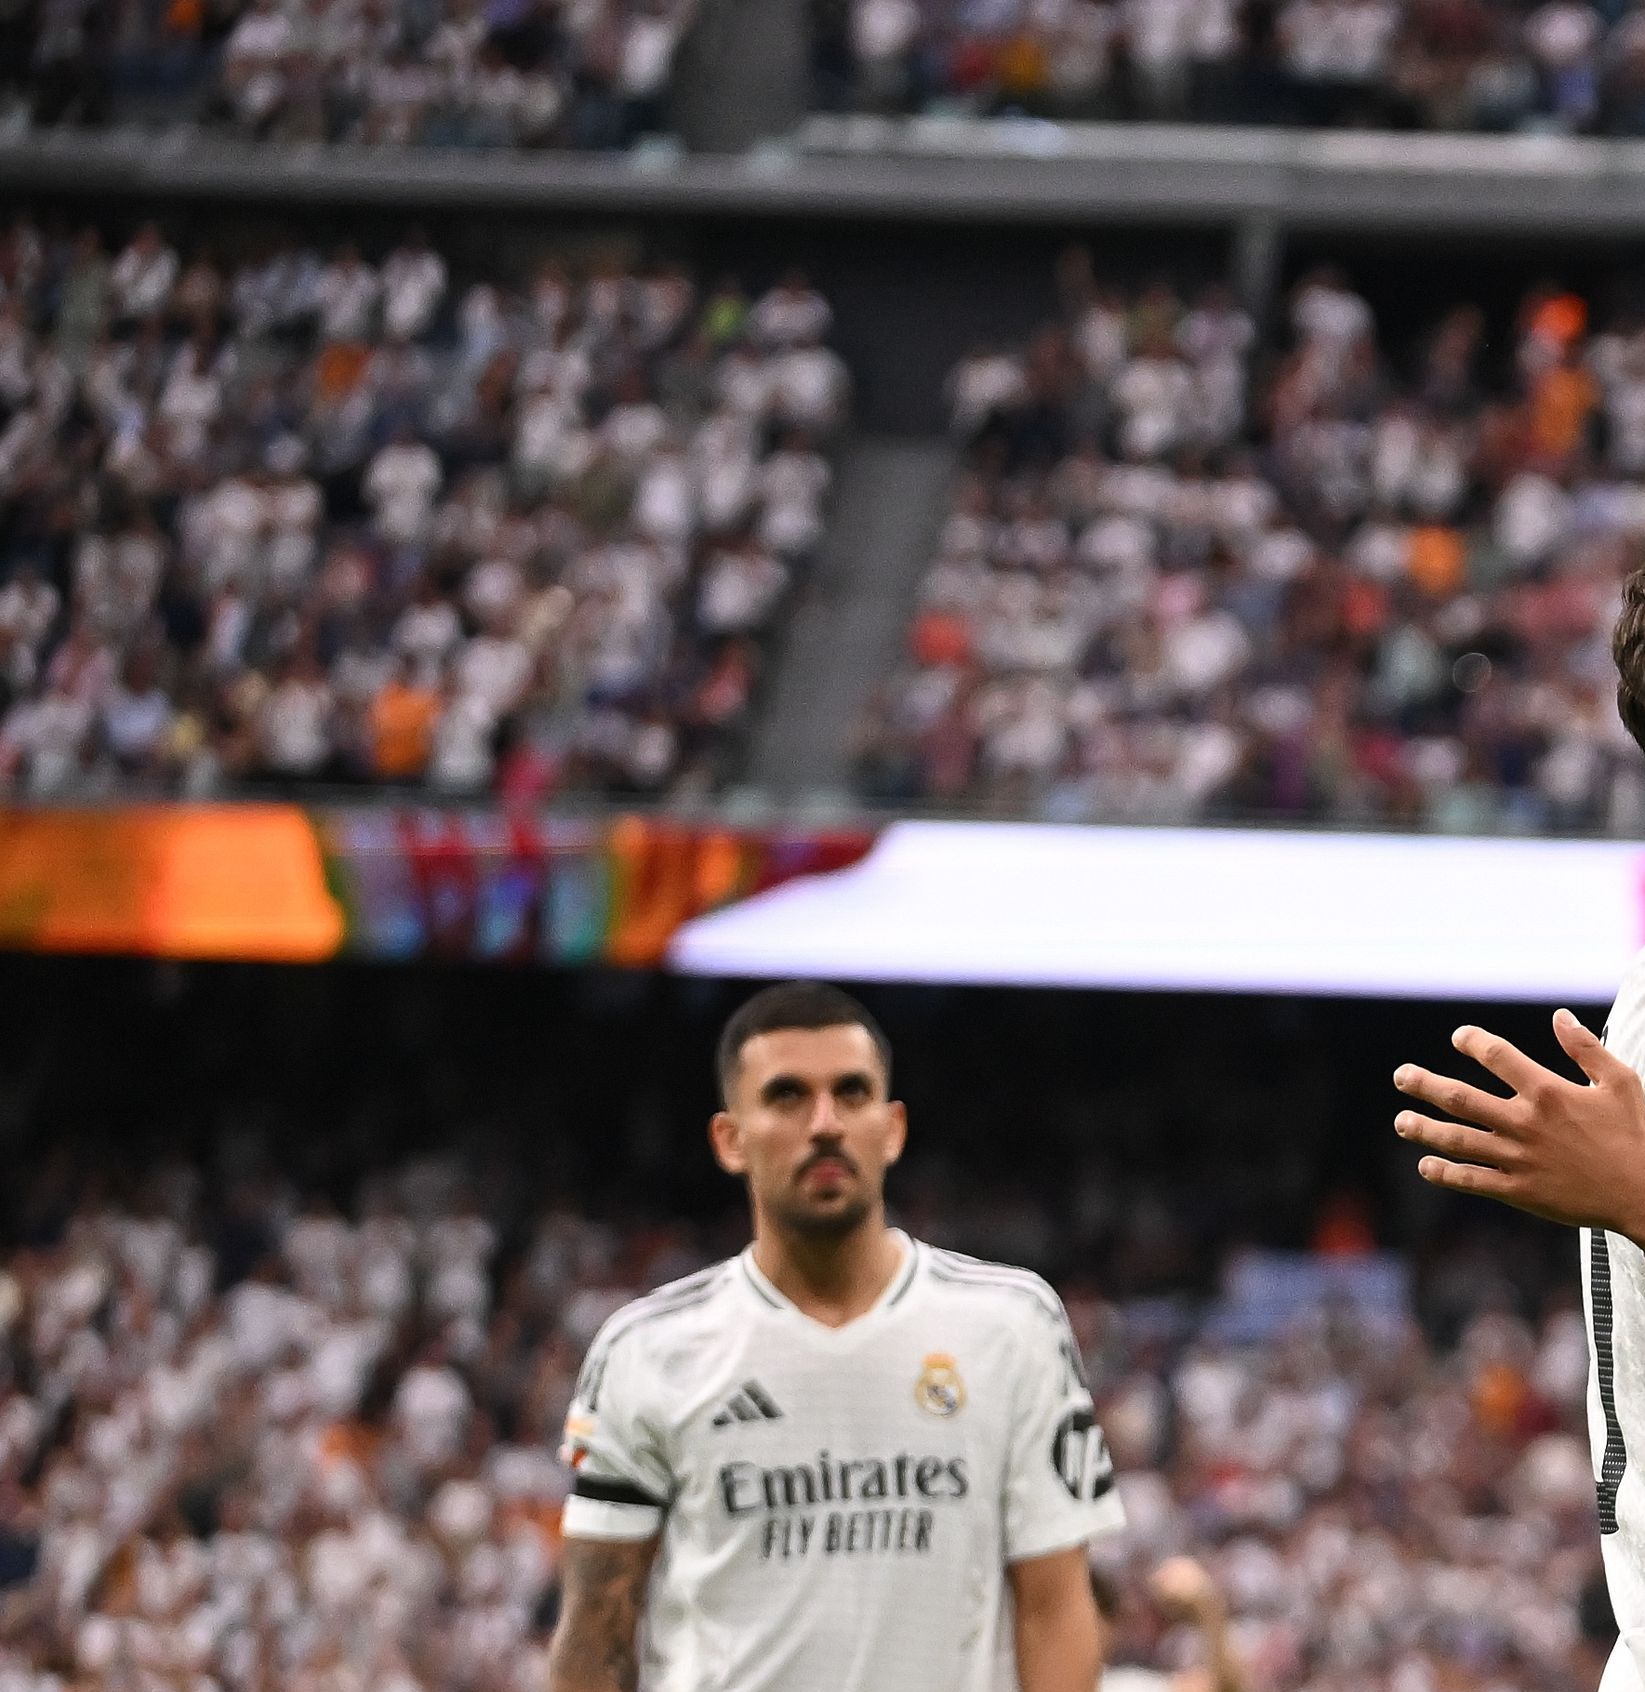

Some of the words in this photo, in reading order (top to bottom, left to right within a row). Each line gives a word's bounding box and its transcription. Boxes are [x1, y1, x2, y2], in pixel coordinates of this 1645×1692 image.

[718, 1448, 969, 1514] Emirates
[761, 1514, 817, 1559] FLY
[825, 1506, 935, 1554] BETTER
